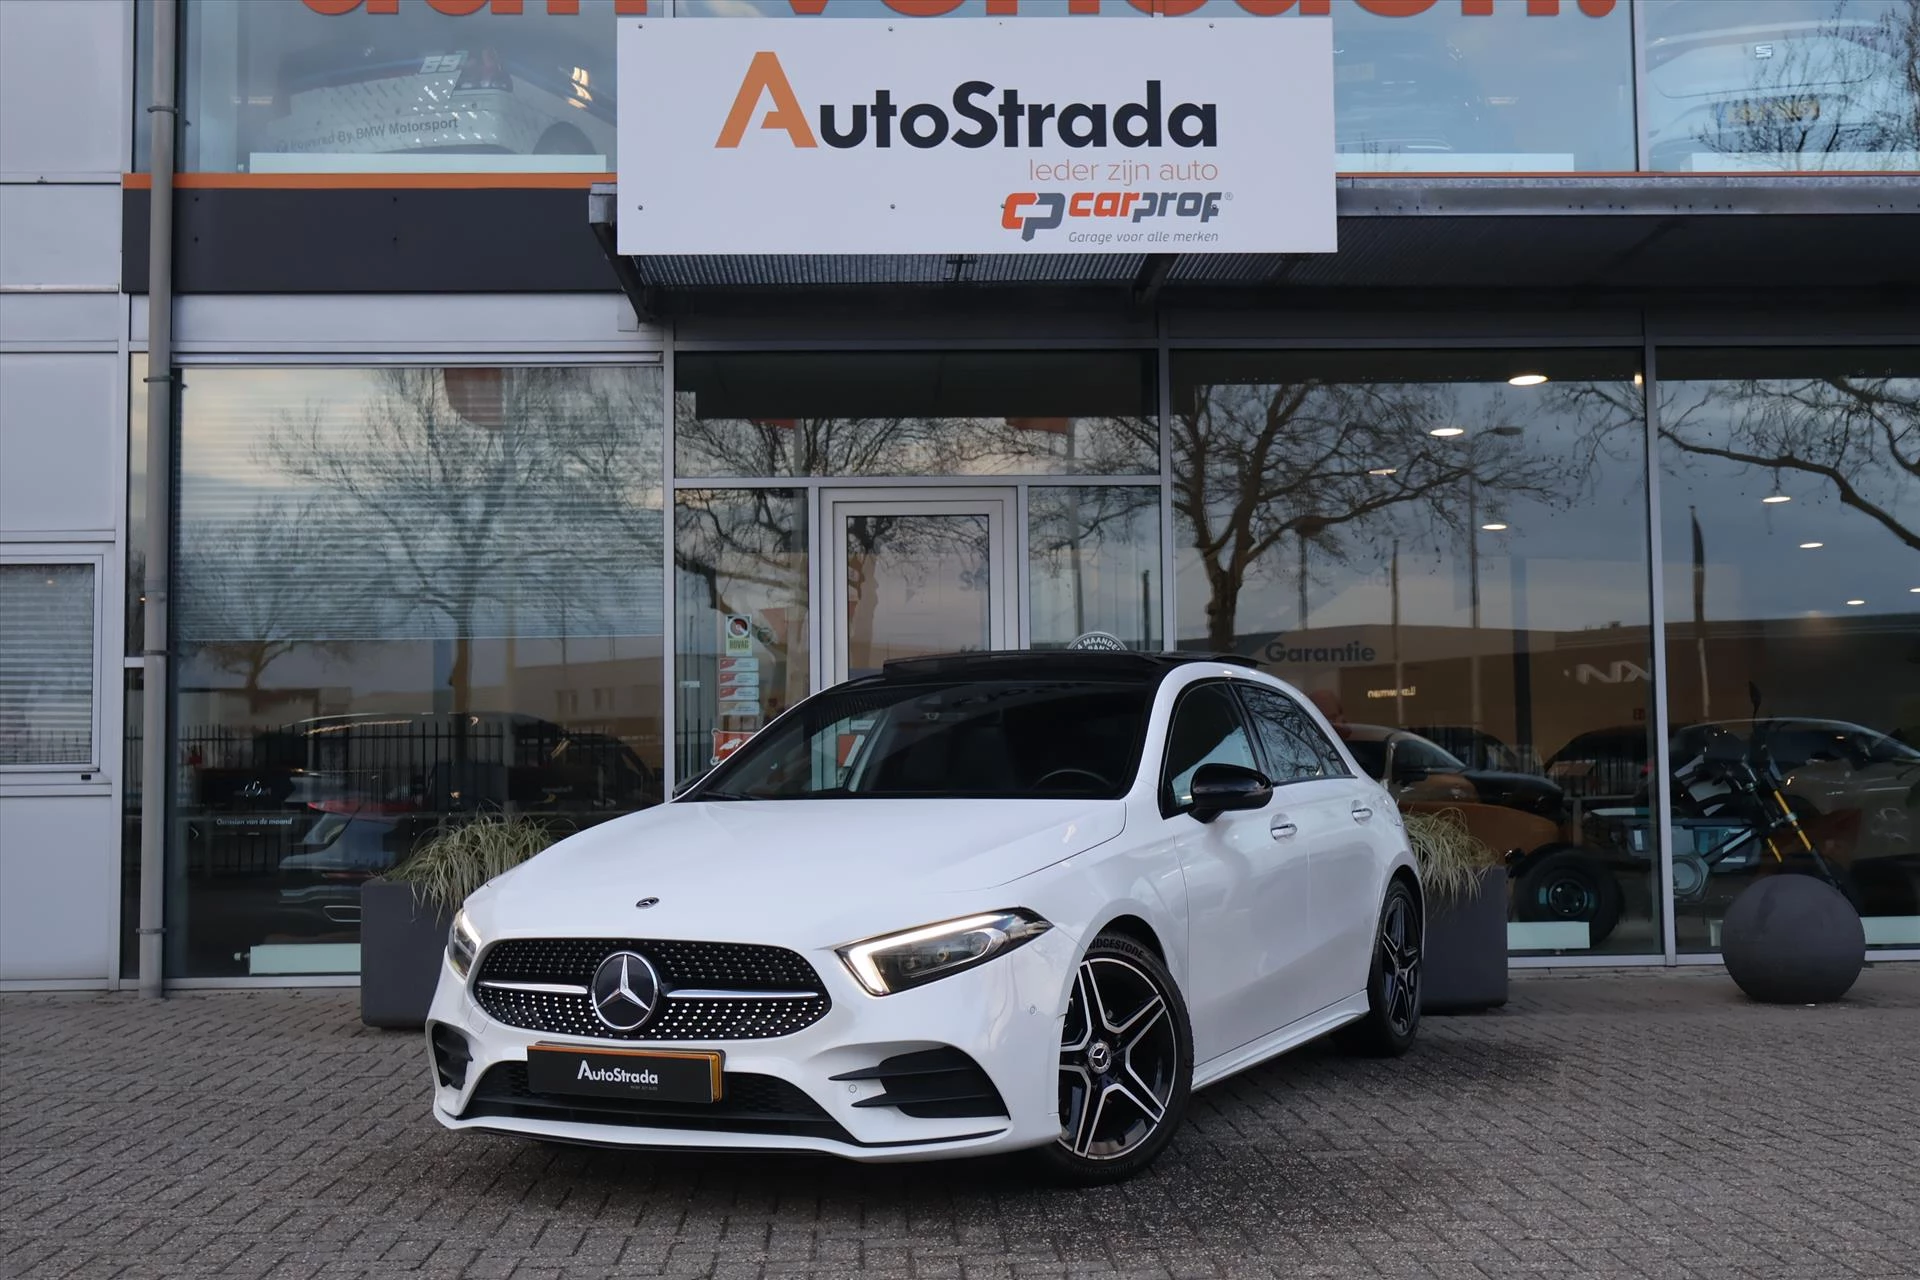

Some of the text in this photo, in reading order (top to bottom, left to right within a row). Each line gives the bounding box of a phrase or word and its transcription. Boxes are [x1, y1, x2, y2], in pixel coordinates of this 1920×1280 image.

[420, 54, 462, 74] 69
[713, 51, 1219, 149] AutoStrada
[290, 116, 459, 151] Powered By BMW Motorsport
[1029, 159, 1219, 187] Ieder zijn auto
[1068, 231, 1219, 246] Garage voor alle merken
[1083, 636, 1121, 651] MAANDE
[1264, 640, 1377, 663] Garantie
[1089, 937, 1144, 959] IDGESTONE
[576, 1059, 659, 1085] AutoStrada
